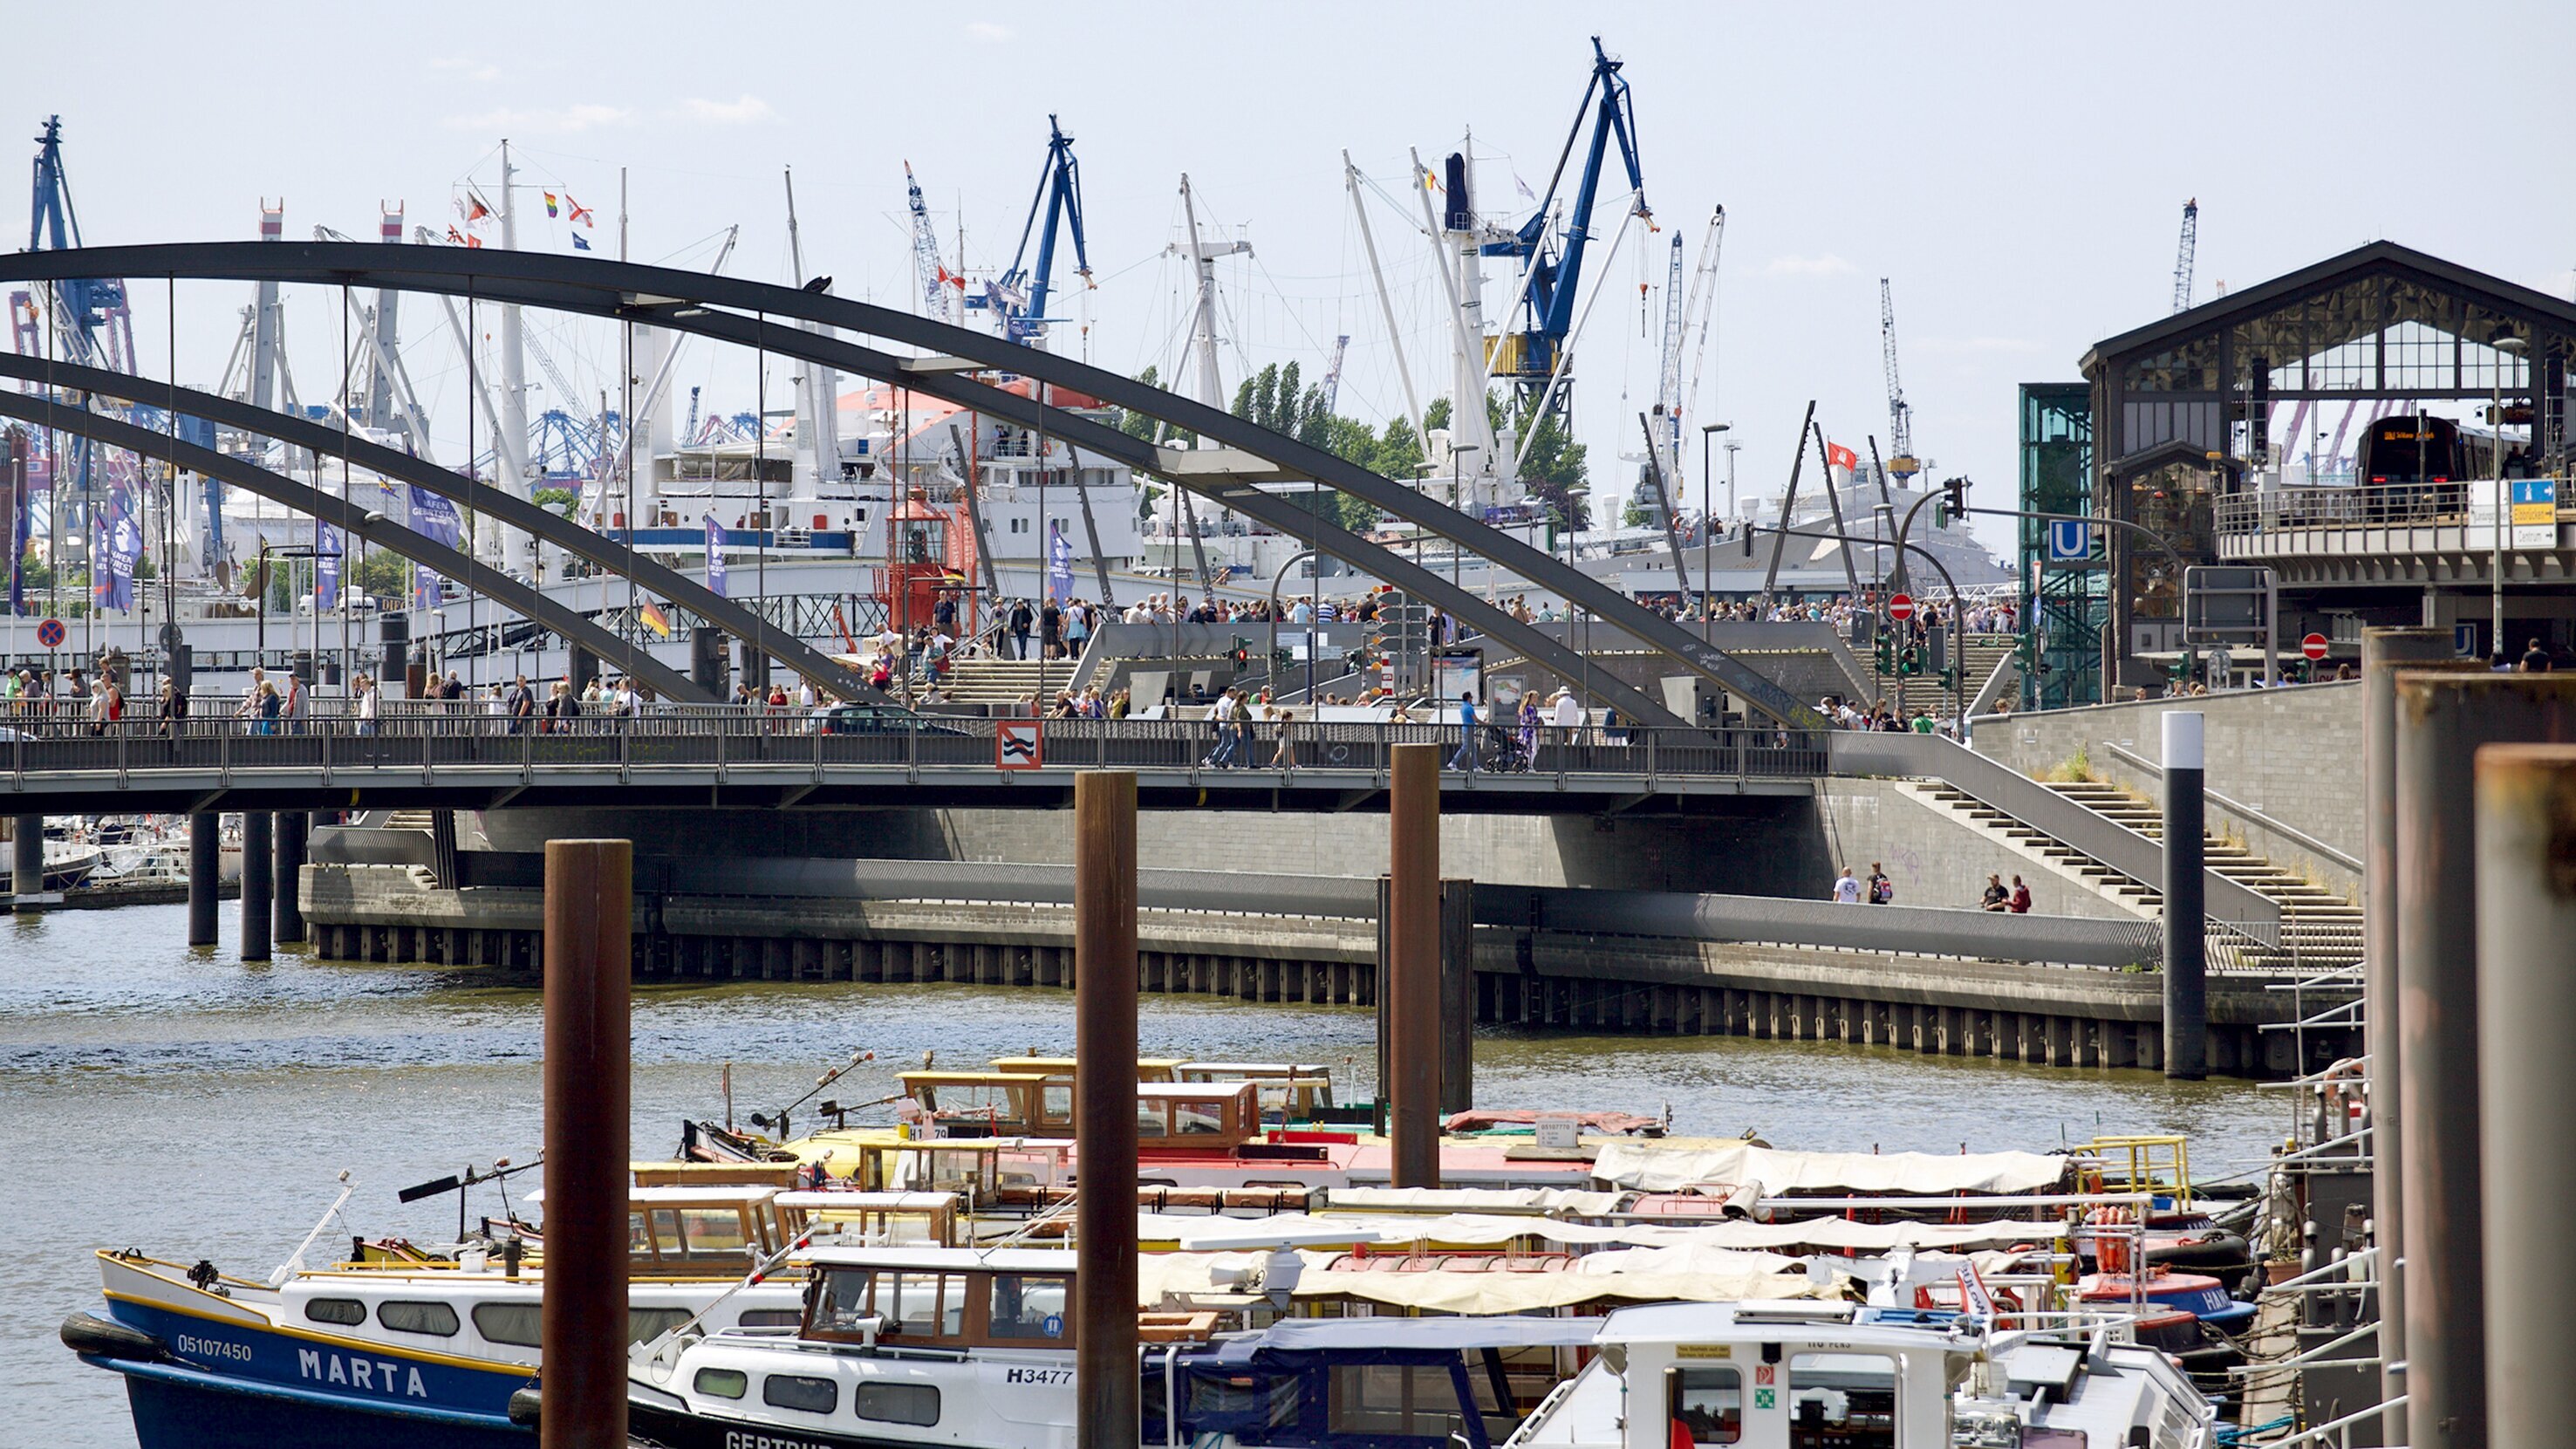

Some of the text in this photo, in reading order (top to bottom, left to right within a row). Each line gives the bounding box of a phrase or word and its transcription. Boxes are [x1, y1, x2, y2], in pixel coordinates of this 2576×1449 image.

[2055, 523, 2084, 556] U
[178, 1334, 252, 1362] 05107450
[298, 1348, 427, 1398] MARTA
[1006, 1368, 1074, 1385] H3477
